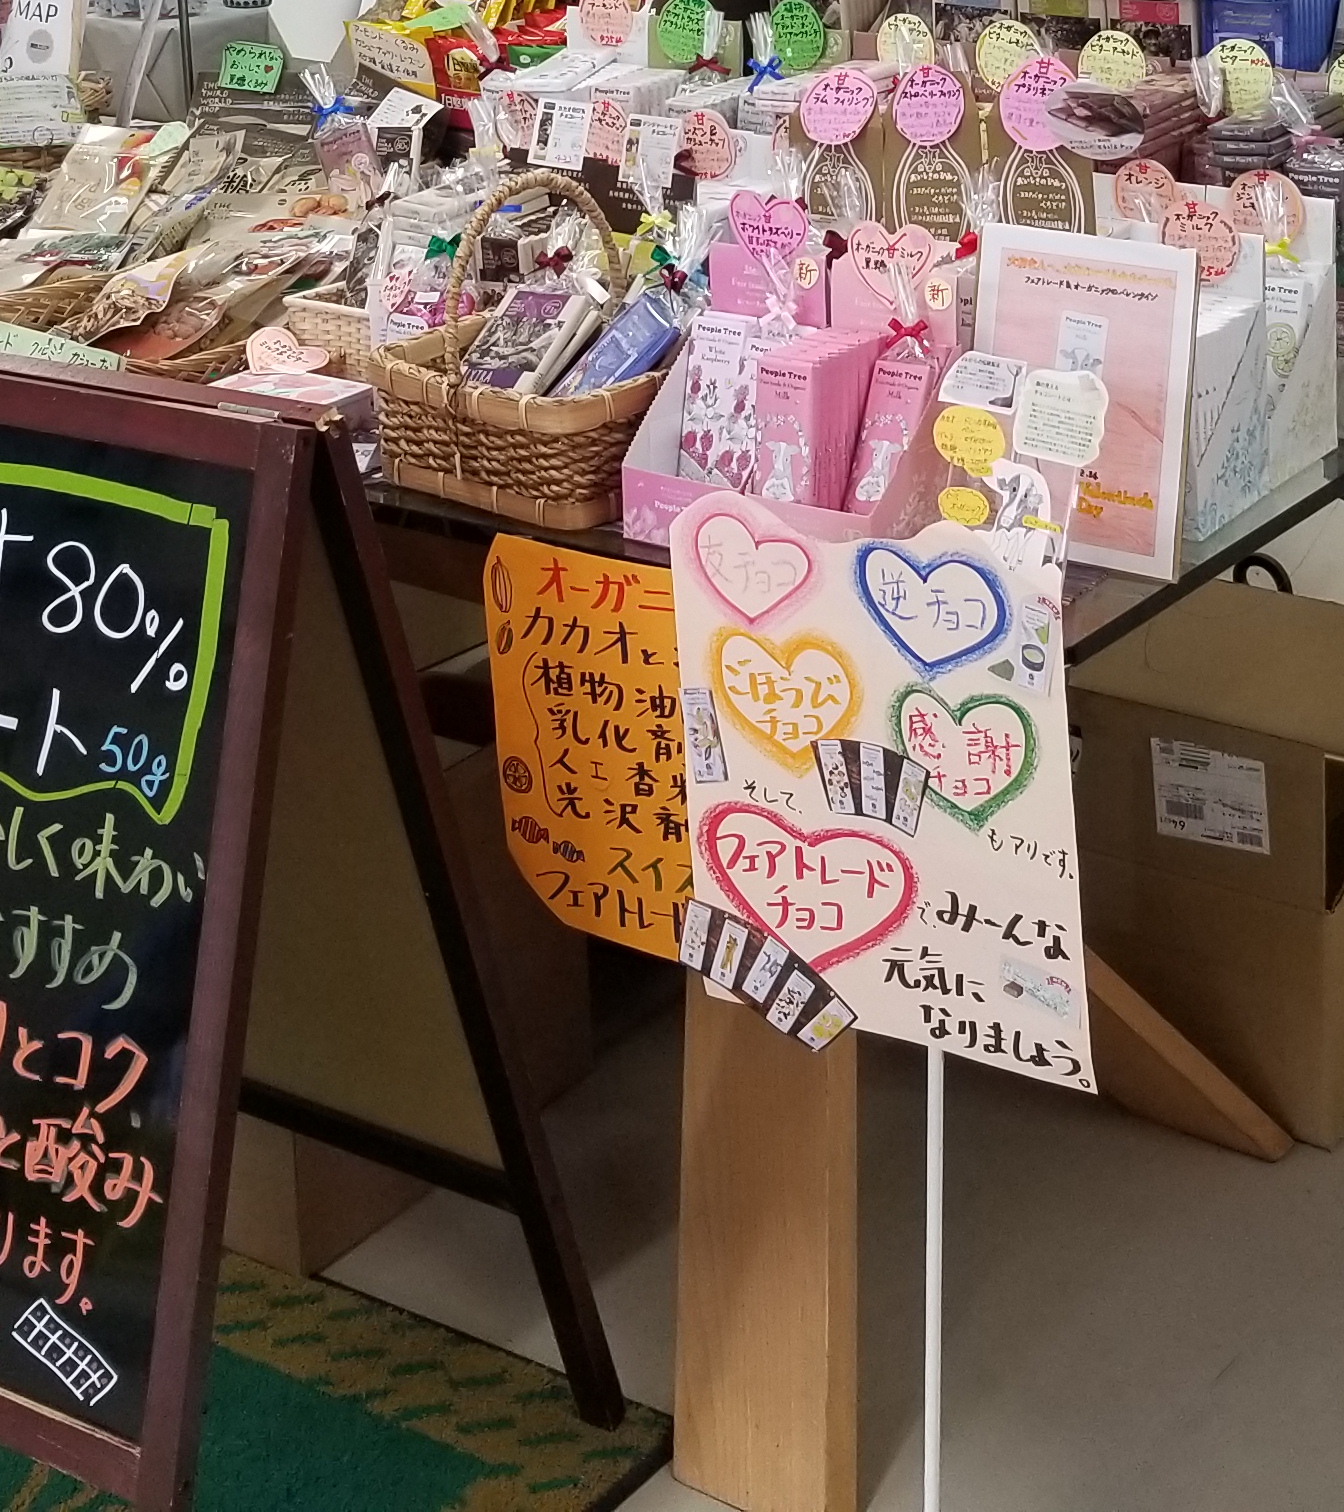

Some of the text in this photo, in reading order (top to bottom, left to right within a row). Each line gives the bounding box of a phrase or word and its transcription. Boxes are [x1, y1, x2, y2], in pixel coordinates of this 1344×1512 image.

[15, 1, 58, 24] MAP
[918, 65, 933, 79] 甘
[1036, 57, 1054, 75] 甘
[834, 72, 850, 86] 甘
[200, 97, 233, 106] WORLD
[614, 88, 630, 97] Tree
[1124, 172, 1166, 190] オレンジ
[1289, 171, 1340, 185] People Tree
[1179, 221, 1213, 233] ミルク
[796, 261, 819, 284] 新
[927, 282, 949, 306] 新
[697, 323, 742, 337] People Tree
[760, 366, 807, 382] People Tree
[877, 366, 923, 382] People Tree
[699, 536, 799, 597] 友チョコ
[877, 568, 989, 633] 逆チョコ
[530, 657, 677, 721] 植物油
[726, 656, 845, 708] ごほうび
[756, 707, 825, 746] チョコ
[907, 706, 1022, 778] 感謝
[100, 726, 169, 797] 50g
[928, 764, 996, 800] チョコ
[715, 829, 897, 899] フェアトレード
[766, 885, 844, 933] チョコ
[882, 942, 987, 1005] 元気に
[919, 1003, 1093, 1091] なりましょう。
